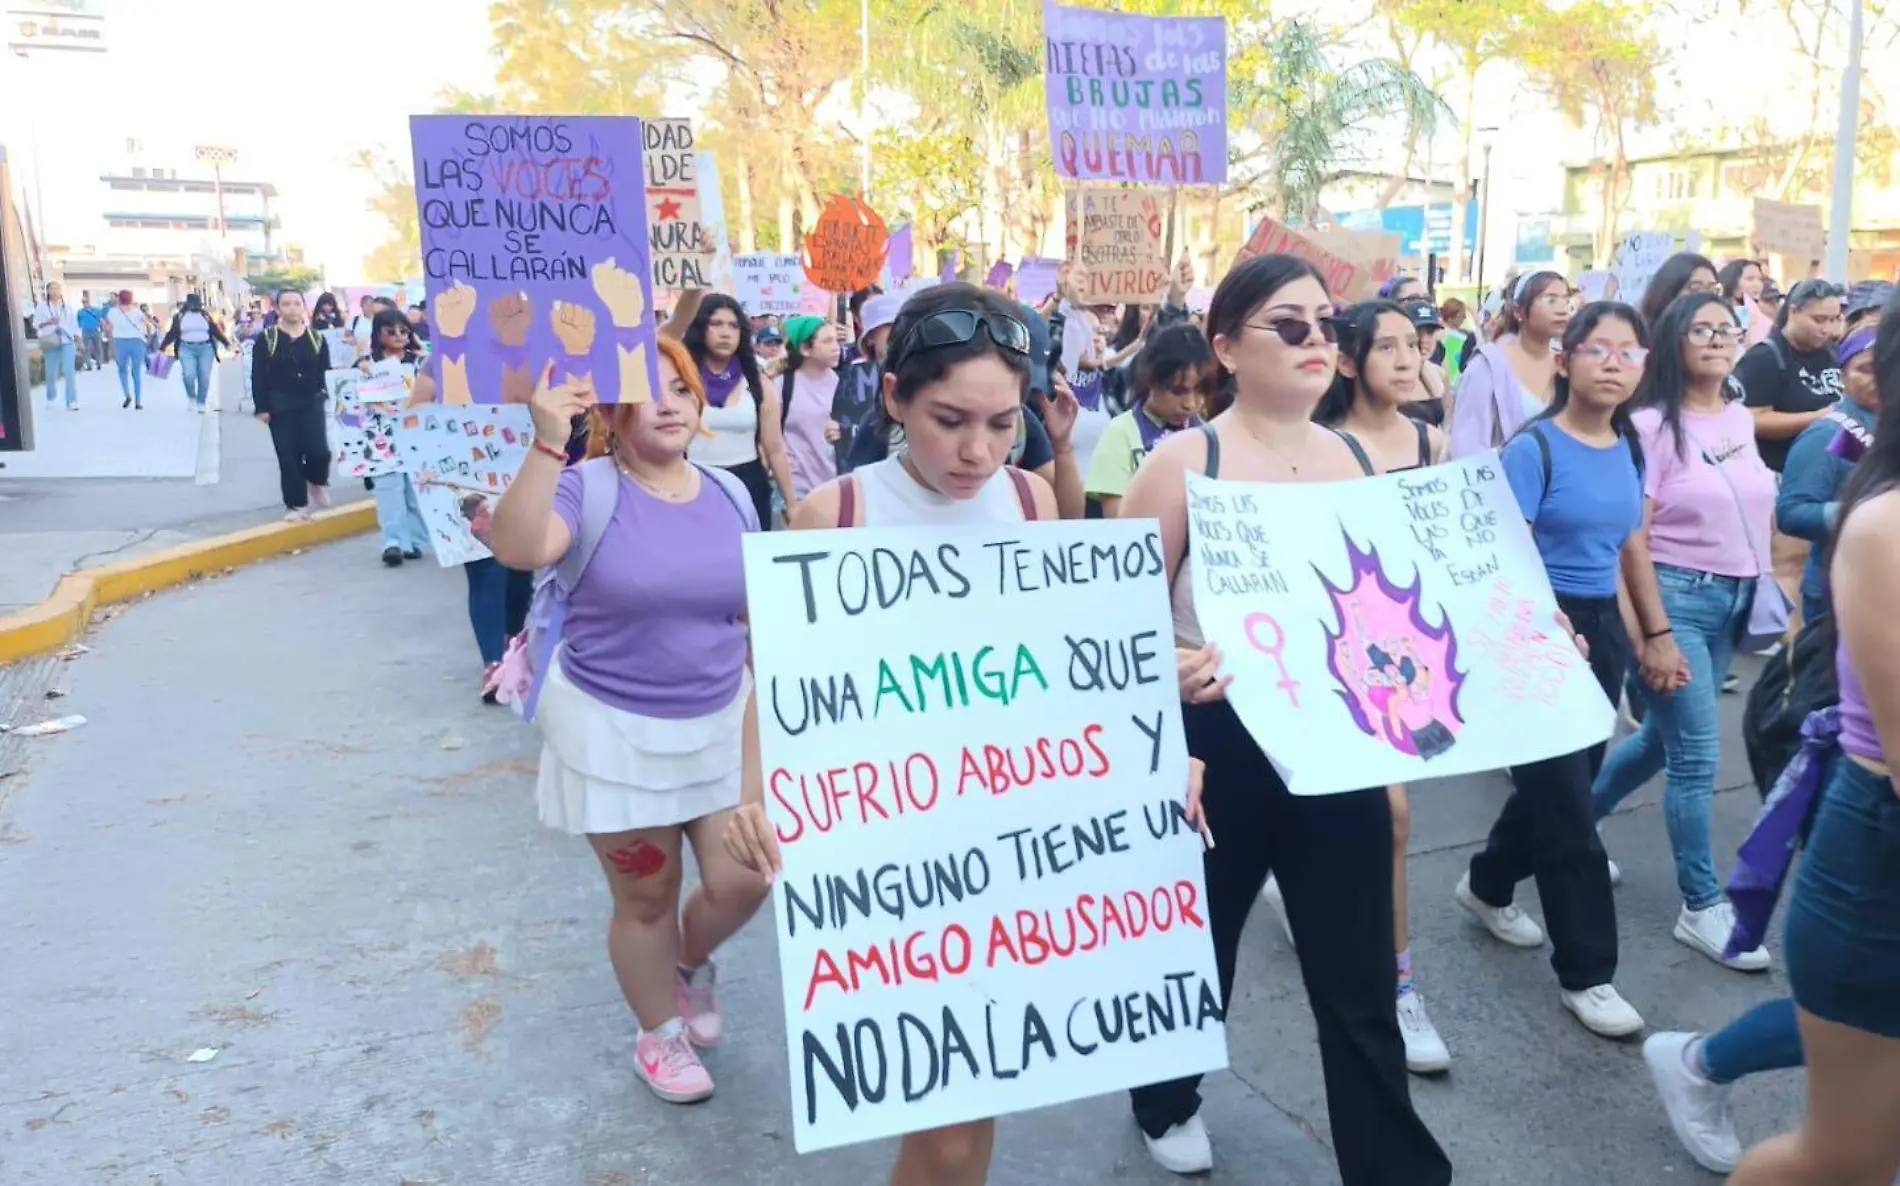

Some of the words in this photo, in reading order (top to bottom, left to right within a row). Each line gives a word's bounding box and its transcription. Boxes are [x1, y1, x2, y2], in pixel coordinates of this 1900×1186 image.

[1066, 75, 1204, 109] BRUJAS
[465, 122, 573, 157] SOMOS
[1060, 129, 1203, 183] QUEMAR
[423, 158, 483, 191] LAS
[489, 157, 612, 202] VOCES
[423, 199, 490, 230] QUE
[496, 198, 617, 235] NUNCA
[424, 248, 588, 281] CALLARÁN
[503, 231, 542, 255] SE
[1460, 510, 1497, 533] QUE
[1464, 528, 1497, 549] NO
[772, 542, 971, 624] TODAS
[982, 533, 1164, 595] TENEMOS
[771, 672, 863, 736] UNA
[874, 643, 1049, 718] AMIGA
[1064, 630, 1160, 692] QUE
[769, 752, 940, 844] SUFRIO
[956, 723, 1111, 796] ABUSOS
[1131, 710, 1164, 775] Y
[783, 846, 991, 937] NINGUNO
[997, 810, 1131, 884] TIENE
[1143, 799, 1200, 840] UN
[804, 922, 972, 1011] AMIGO
[986, 880, 1205, 968] ABUSADOR
[801, 1017, 887, 1126] NO
[897, 1004, 981, 1104] DA
[985, 999, 1057, 1080] LA
[1067, 971, 1226, 1057] CUENTA
